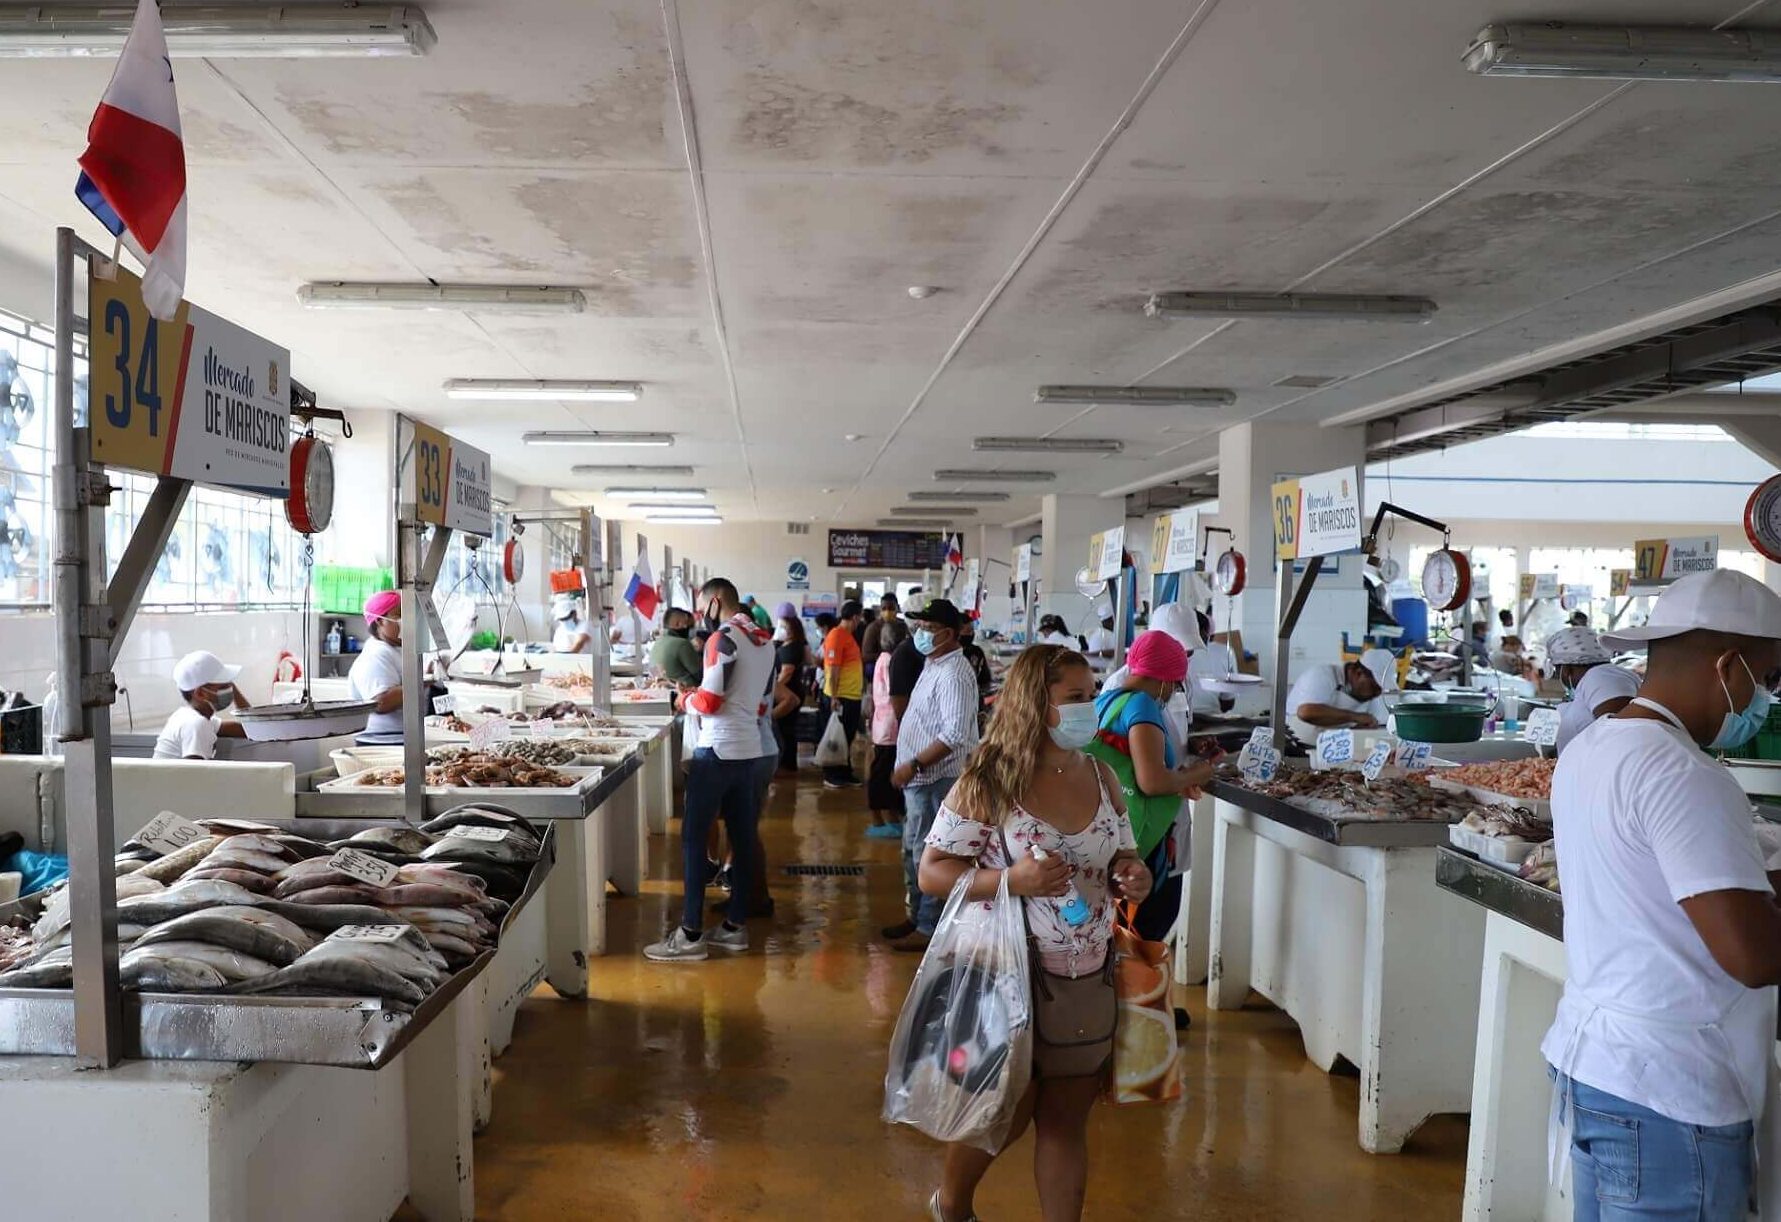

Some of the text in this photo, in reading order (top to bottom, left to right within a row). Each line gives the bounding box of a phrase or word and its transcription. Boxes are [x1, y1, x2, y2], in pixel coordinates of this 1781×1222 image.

[105, 298, 162, 438] 34
[204, 345, 255, 400] Mercado
[205, 389, 285, 454] DE MARISCOS
[420, 440, 441, 507] 33
[456, 480, 490, 513] DE MARISCOS
[1276, 494, 1294, 545] 36
[1308, 507, 1356, 534] DE MARISCOS
[830, 533, 869, 547] Ceviches
[832, 546, 867, 557] Gourmet
[1638, 547, 1655, 579] 47
[1673, 557, 1715, 573] DE MARISCOS
